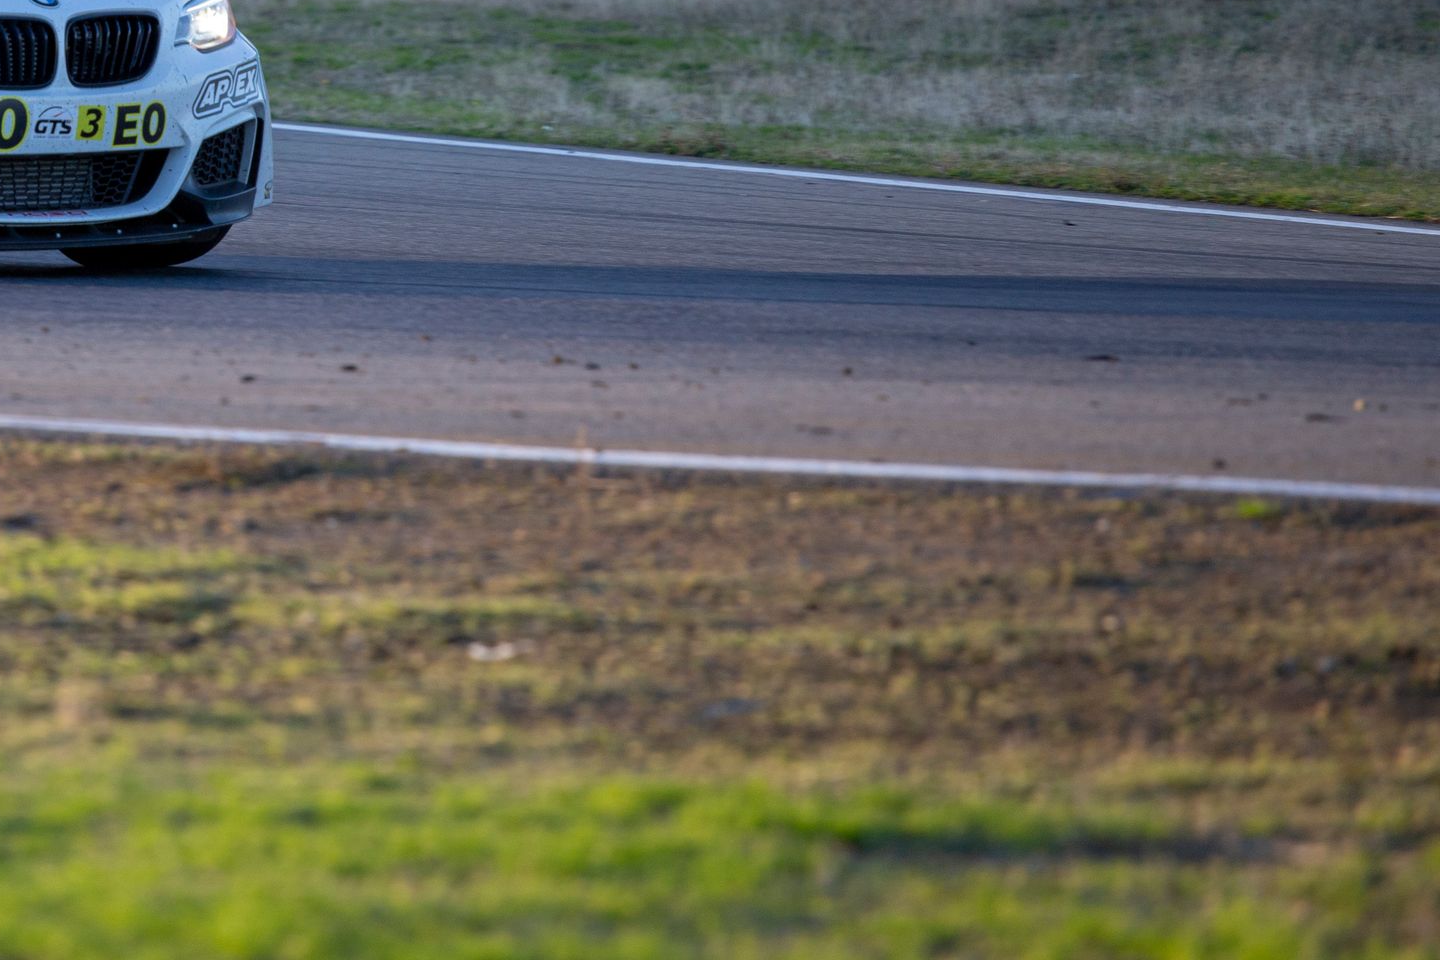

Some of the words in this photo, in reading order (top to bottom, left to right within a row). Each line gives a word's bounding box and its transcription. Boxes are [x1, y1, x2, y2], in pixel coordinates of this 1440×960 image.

[198, 69, 258, 109] APEX
[34, 119, 72, 135] GTS
[79, 107, 102, 138] 3
